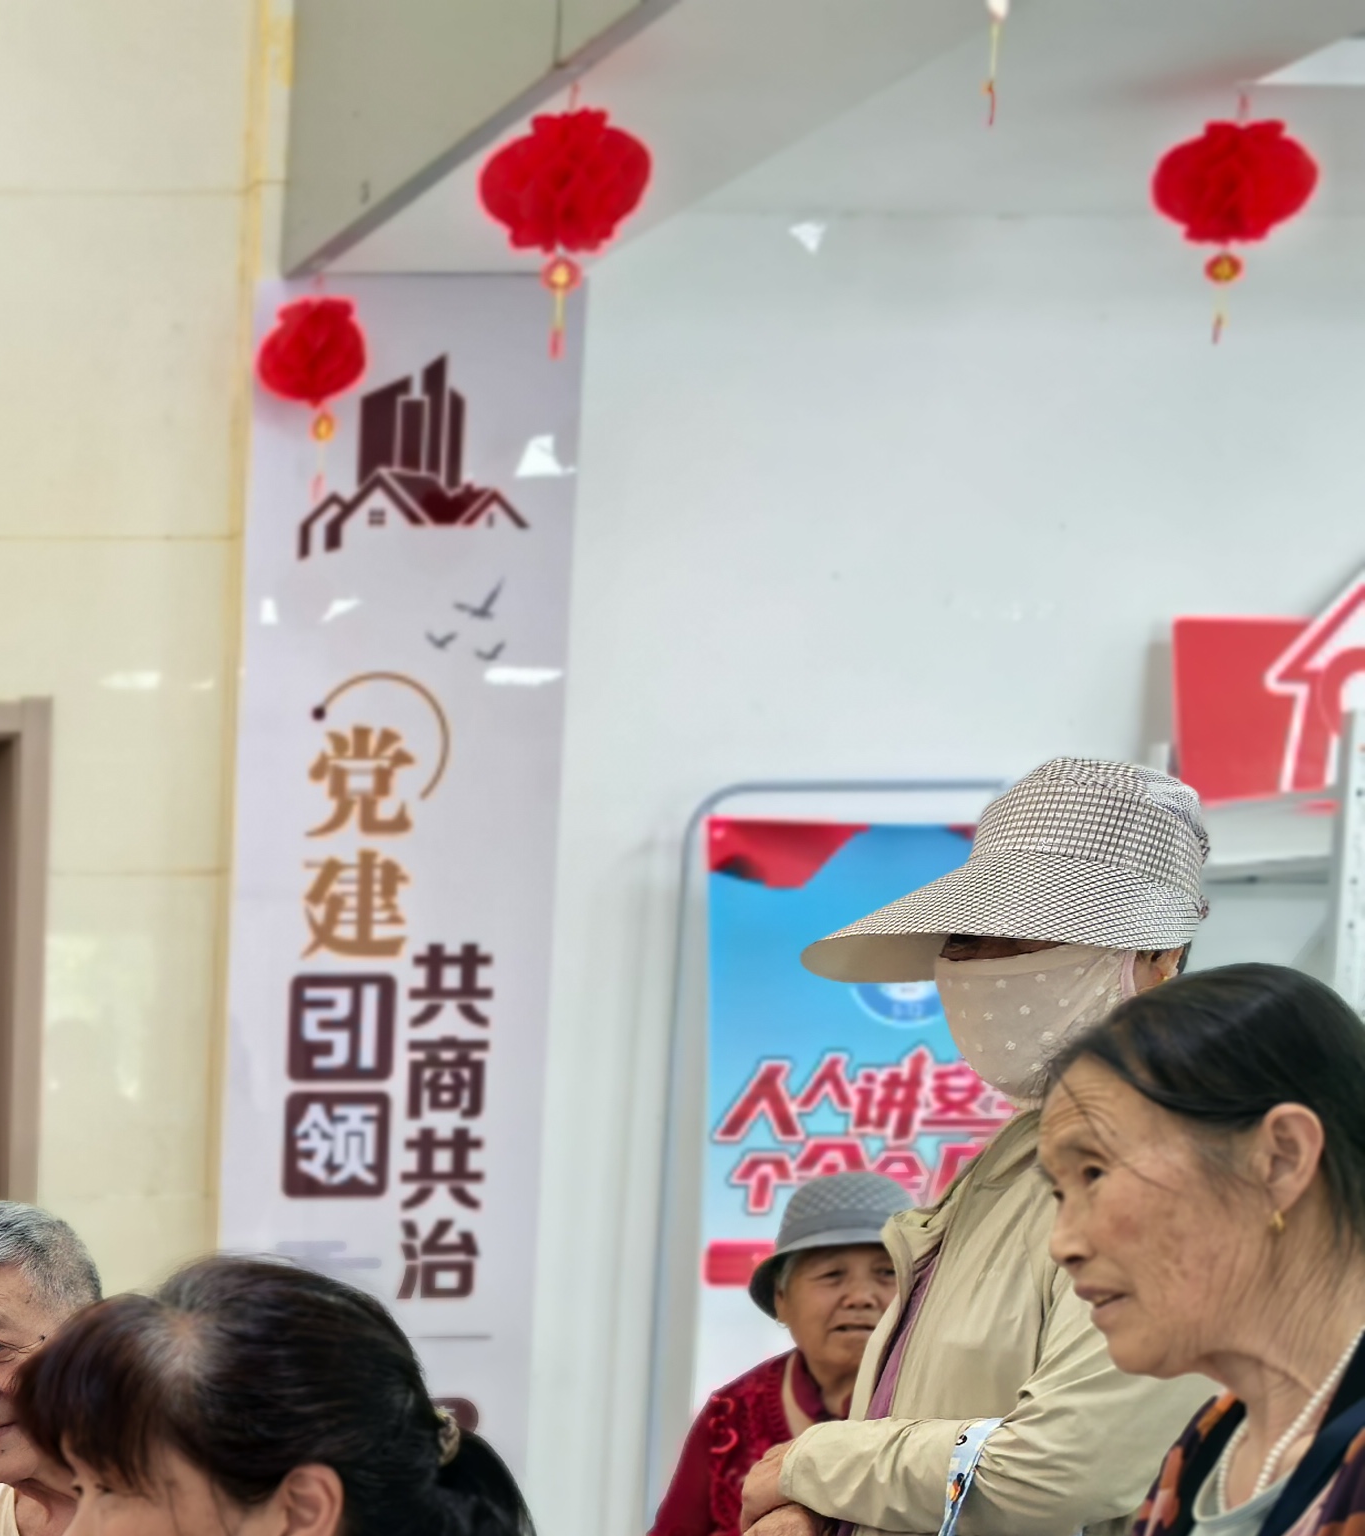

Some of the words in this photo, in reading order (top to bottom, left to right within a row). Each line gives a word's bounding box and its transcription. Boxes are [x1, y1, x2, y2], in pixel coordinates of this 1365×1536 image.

[296, 724, 416, 1187] 党建引领
[396, 943, 494, 1301] 共商共治
[716, 1045, 1017, 1142] 人人讲安
